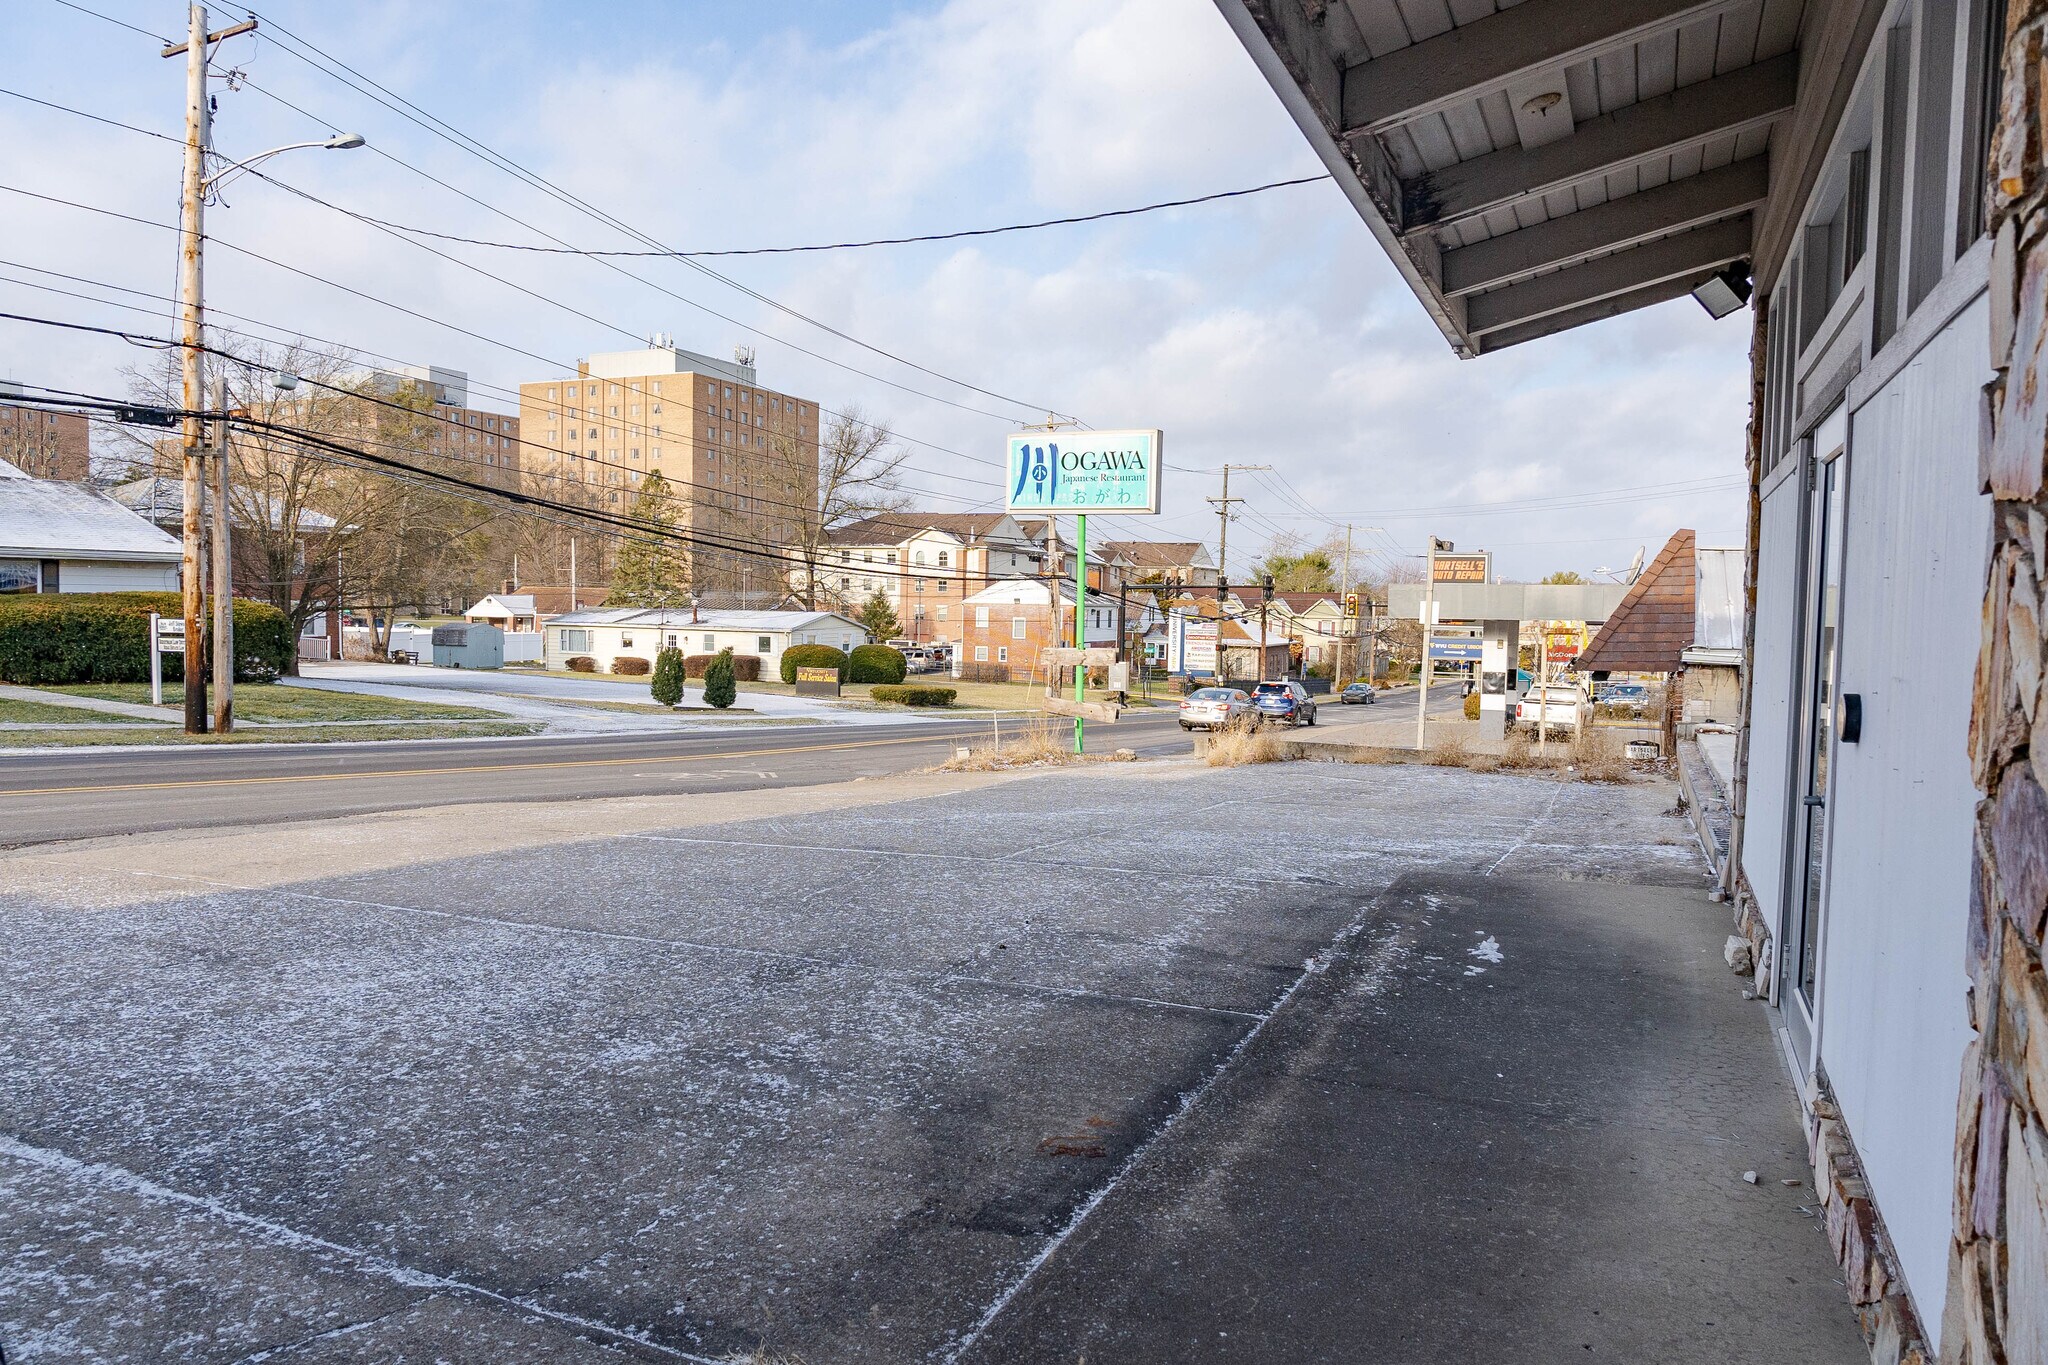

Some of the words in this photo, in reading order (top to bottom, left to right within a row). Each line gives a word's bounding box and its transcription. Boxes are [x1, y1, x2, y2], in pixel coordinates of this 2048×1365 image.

[1061, 450, 1146, 471] OGAWA
[1061, 474, 1099, 485] Japanese
[1100, 473, 1146, 482] Restaurant
[1072, 488, 1132, 505] おがわ
[1434, 570, 1454, 580] AUTO
[1455, 570, 1485, 580] REPAIR
[808, 673, 823, 681] Service
[824, 674, 836, 682] Salon
